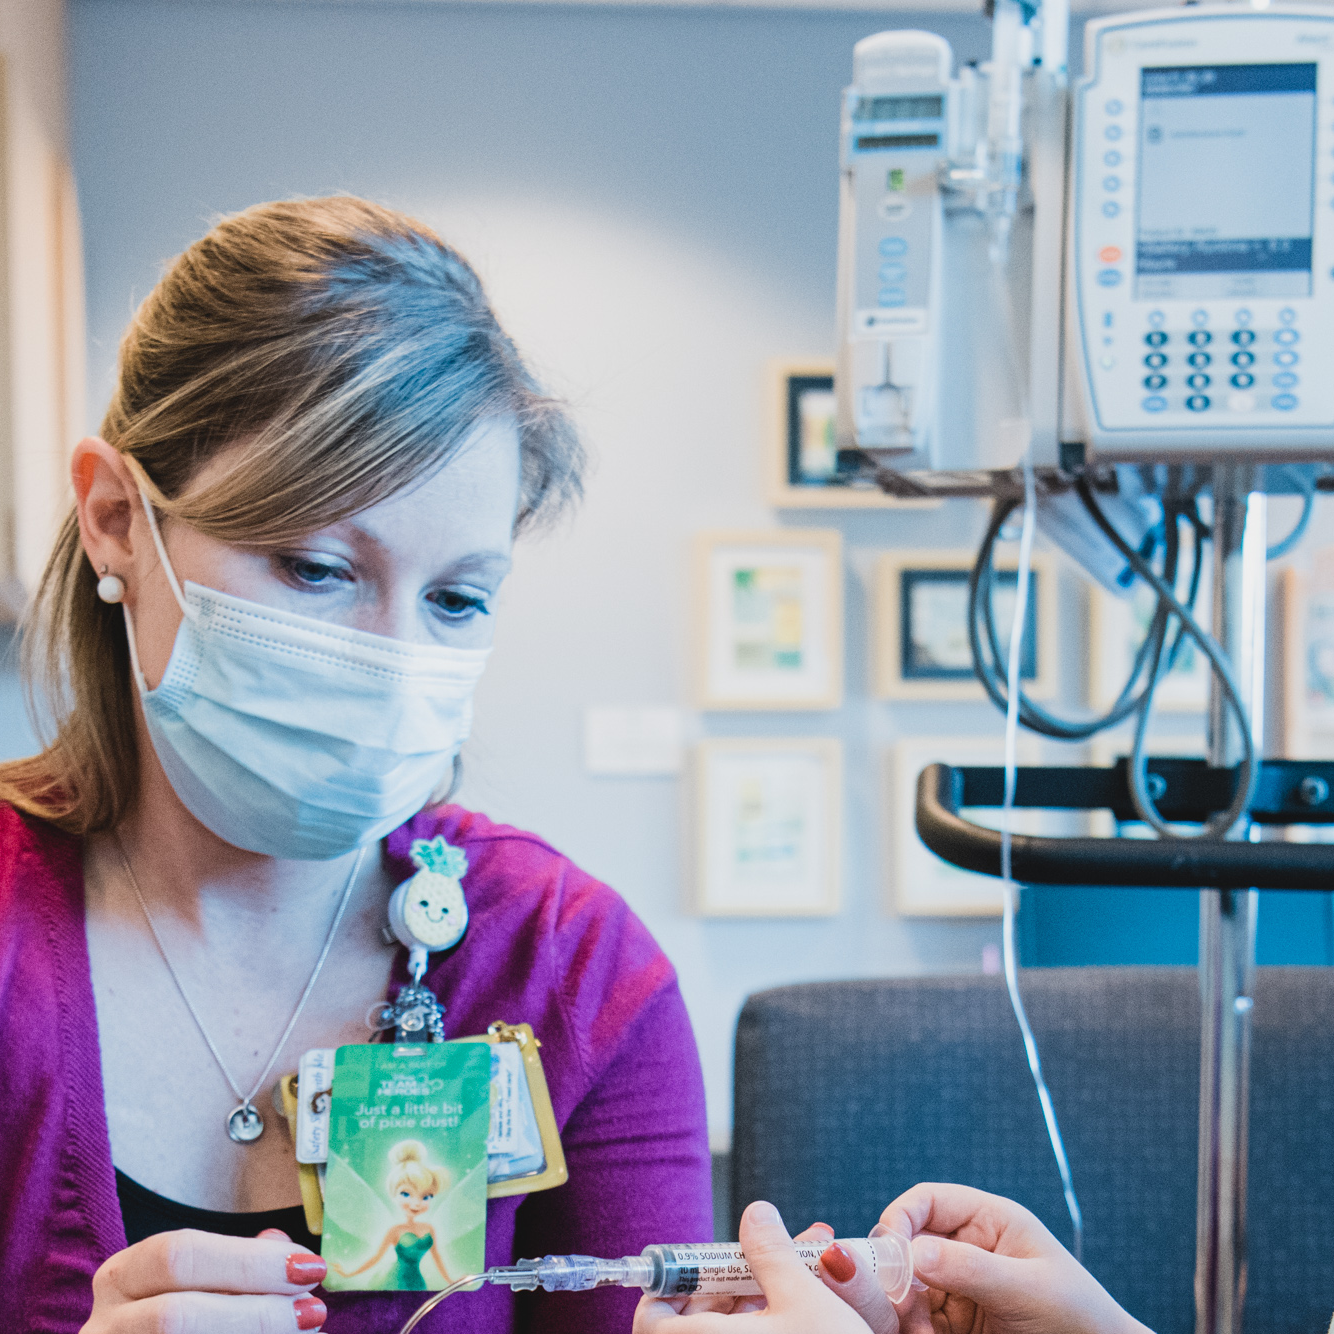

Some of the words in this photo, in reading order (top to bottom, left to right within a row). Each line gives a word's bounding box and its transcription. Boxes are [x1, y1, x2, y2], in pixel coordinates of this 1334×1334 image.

[379, 1080, 418, 1088] TEAM
[377, 1088, 430, 1096] HEROES
[355, 1103, 387, 1116] Just
[391, 1106, 401, 1115] a
[405, 1102, 438, 1115] little
[443, 1102, 463, 1115] bit
[359, 1115, 377, 1129] of
[379, 1116, 416, 1131] pixie
[419, 1115, 459, 1128] dust!
[308, 1126, 324, 1155] Safety
[677, 1252, 699, 1261] 0.9%
[699, 1252, 733, 1260] SODIUM
[679, 1265, 689, 1274] 10
[690, 1265, 701, 1274] mL
[703, 1264, 726, 1276] Single
[727, 1264, 743, 1275] Use,
[689, 1276, 710, 1284] product
[688, 1284, 702, 1292] BD
